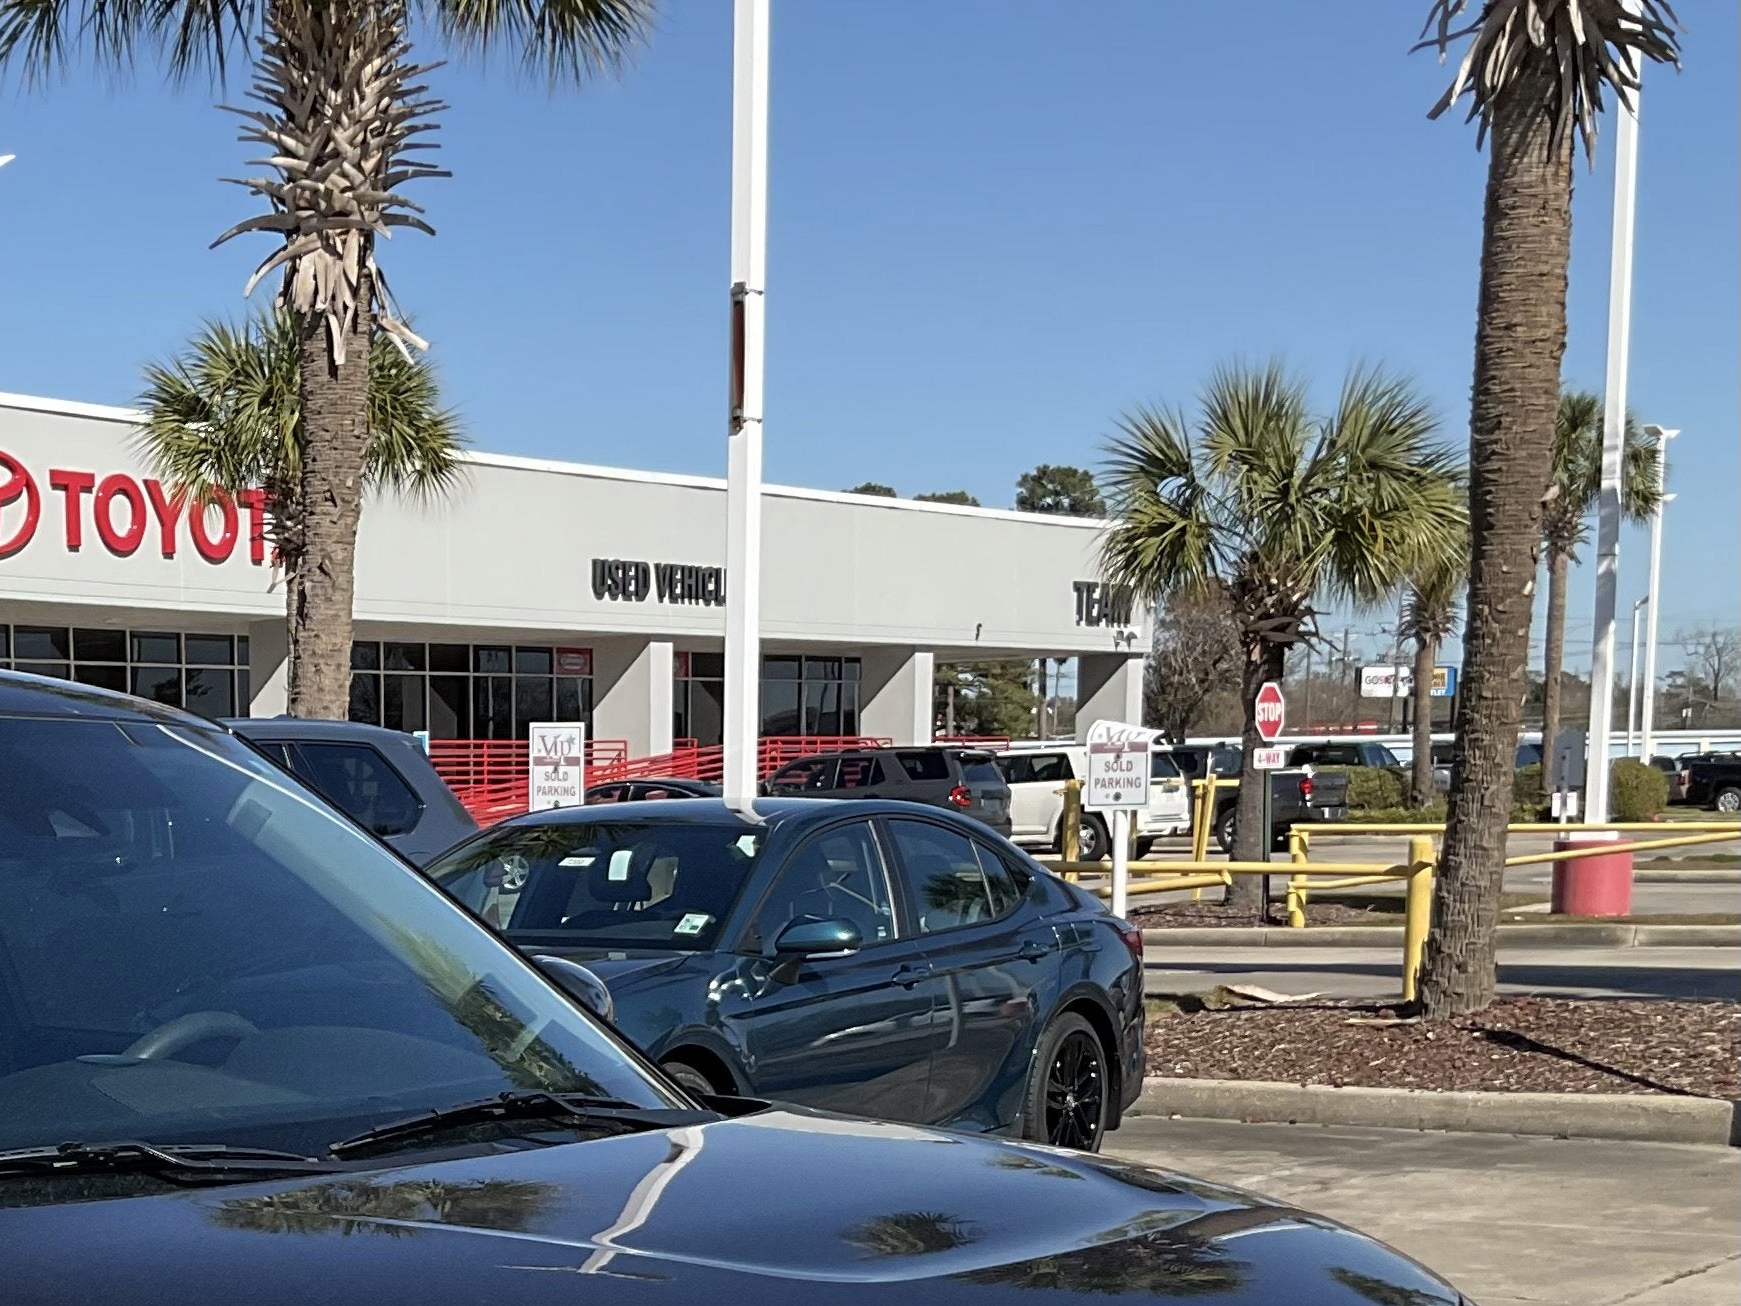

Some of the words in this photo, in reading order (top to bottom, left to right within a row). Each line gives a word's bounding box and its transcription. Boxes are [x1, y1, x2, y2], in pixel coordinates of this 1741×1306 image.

[49, 468, 286, 566] TOYOT
[592, 558, 651, 602] USED
[654, 562, 727, 607] VEHICL
[1257, 702, 1282, 722] STOP
[1258, 752, 1280, 764] 4-WAY
[1104, 760, 1133, 773] SOLD
[544, 771, 569, 782] SOLD
[1094, 777, 1142, 790] PARKING
[536, 785, 576, 797] PARKING
